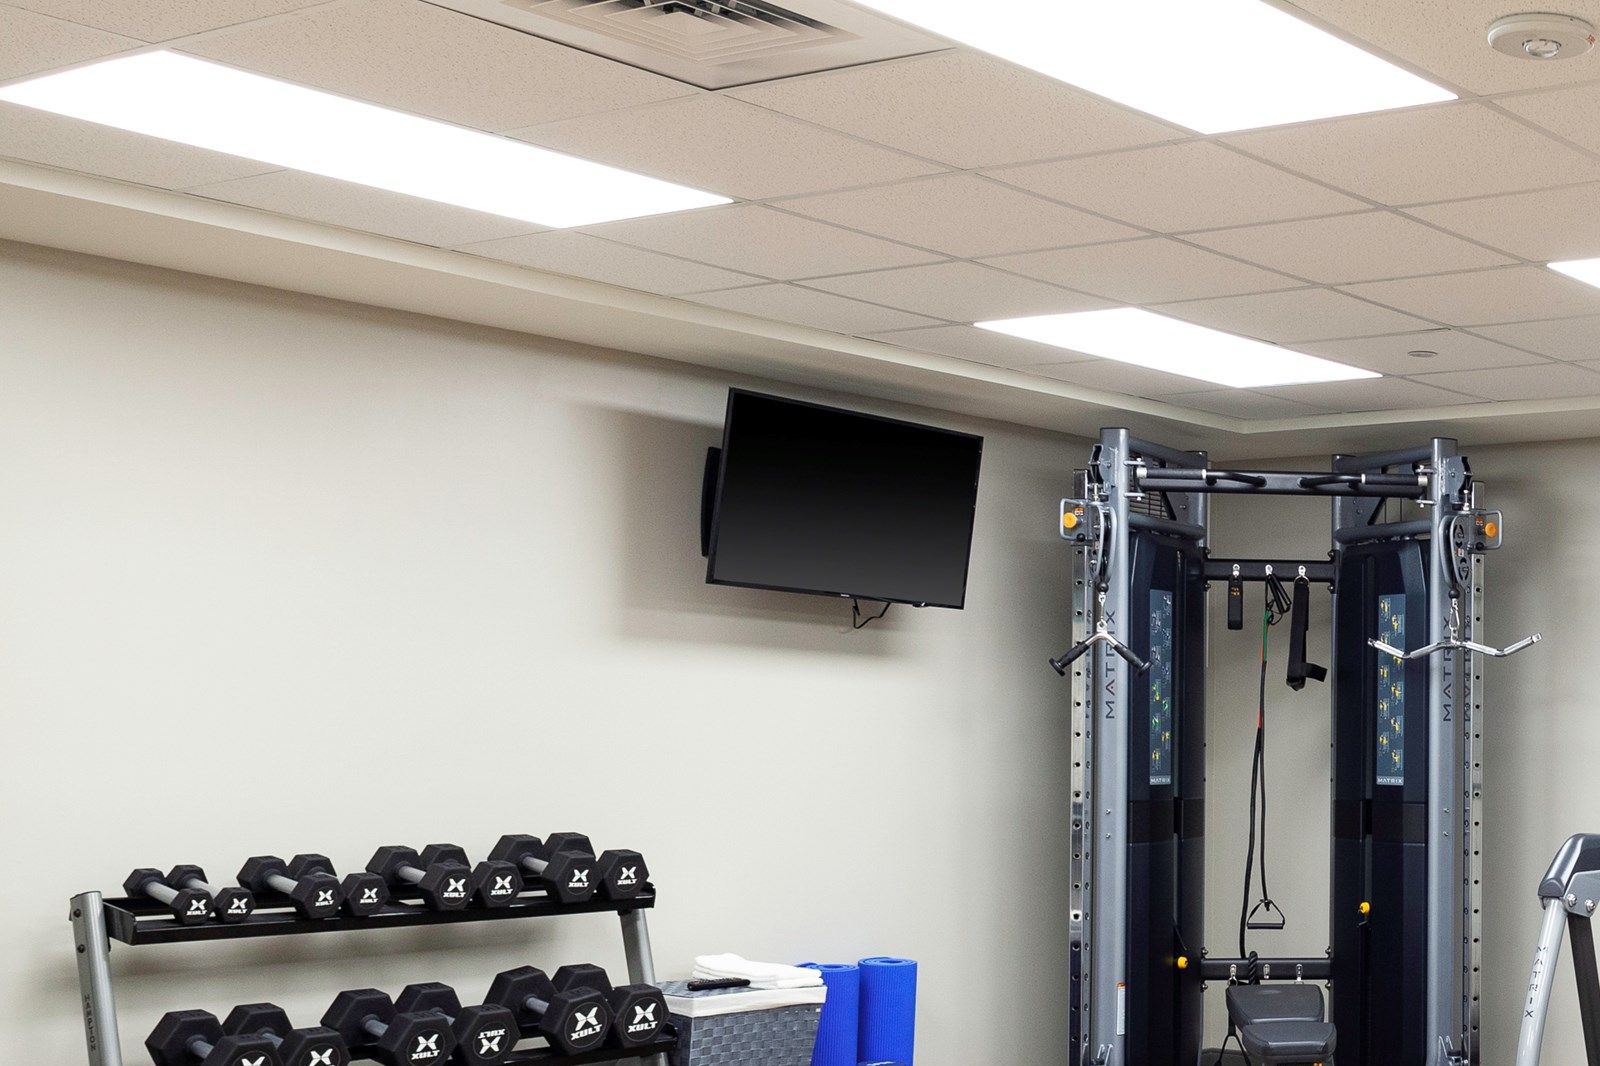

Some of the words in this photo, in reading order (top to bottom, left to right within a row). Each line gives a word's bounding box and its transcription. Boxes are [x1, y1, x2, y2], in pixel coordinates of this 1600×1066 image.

[570, 1024, 602, 1041] XULT
[627, 1021, 658, 1033] XULT
[478, 1028, 506, 1039] XULT
[411, 1050, 440, 1061] XULT
